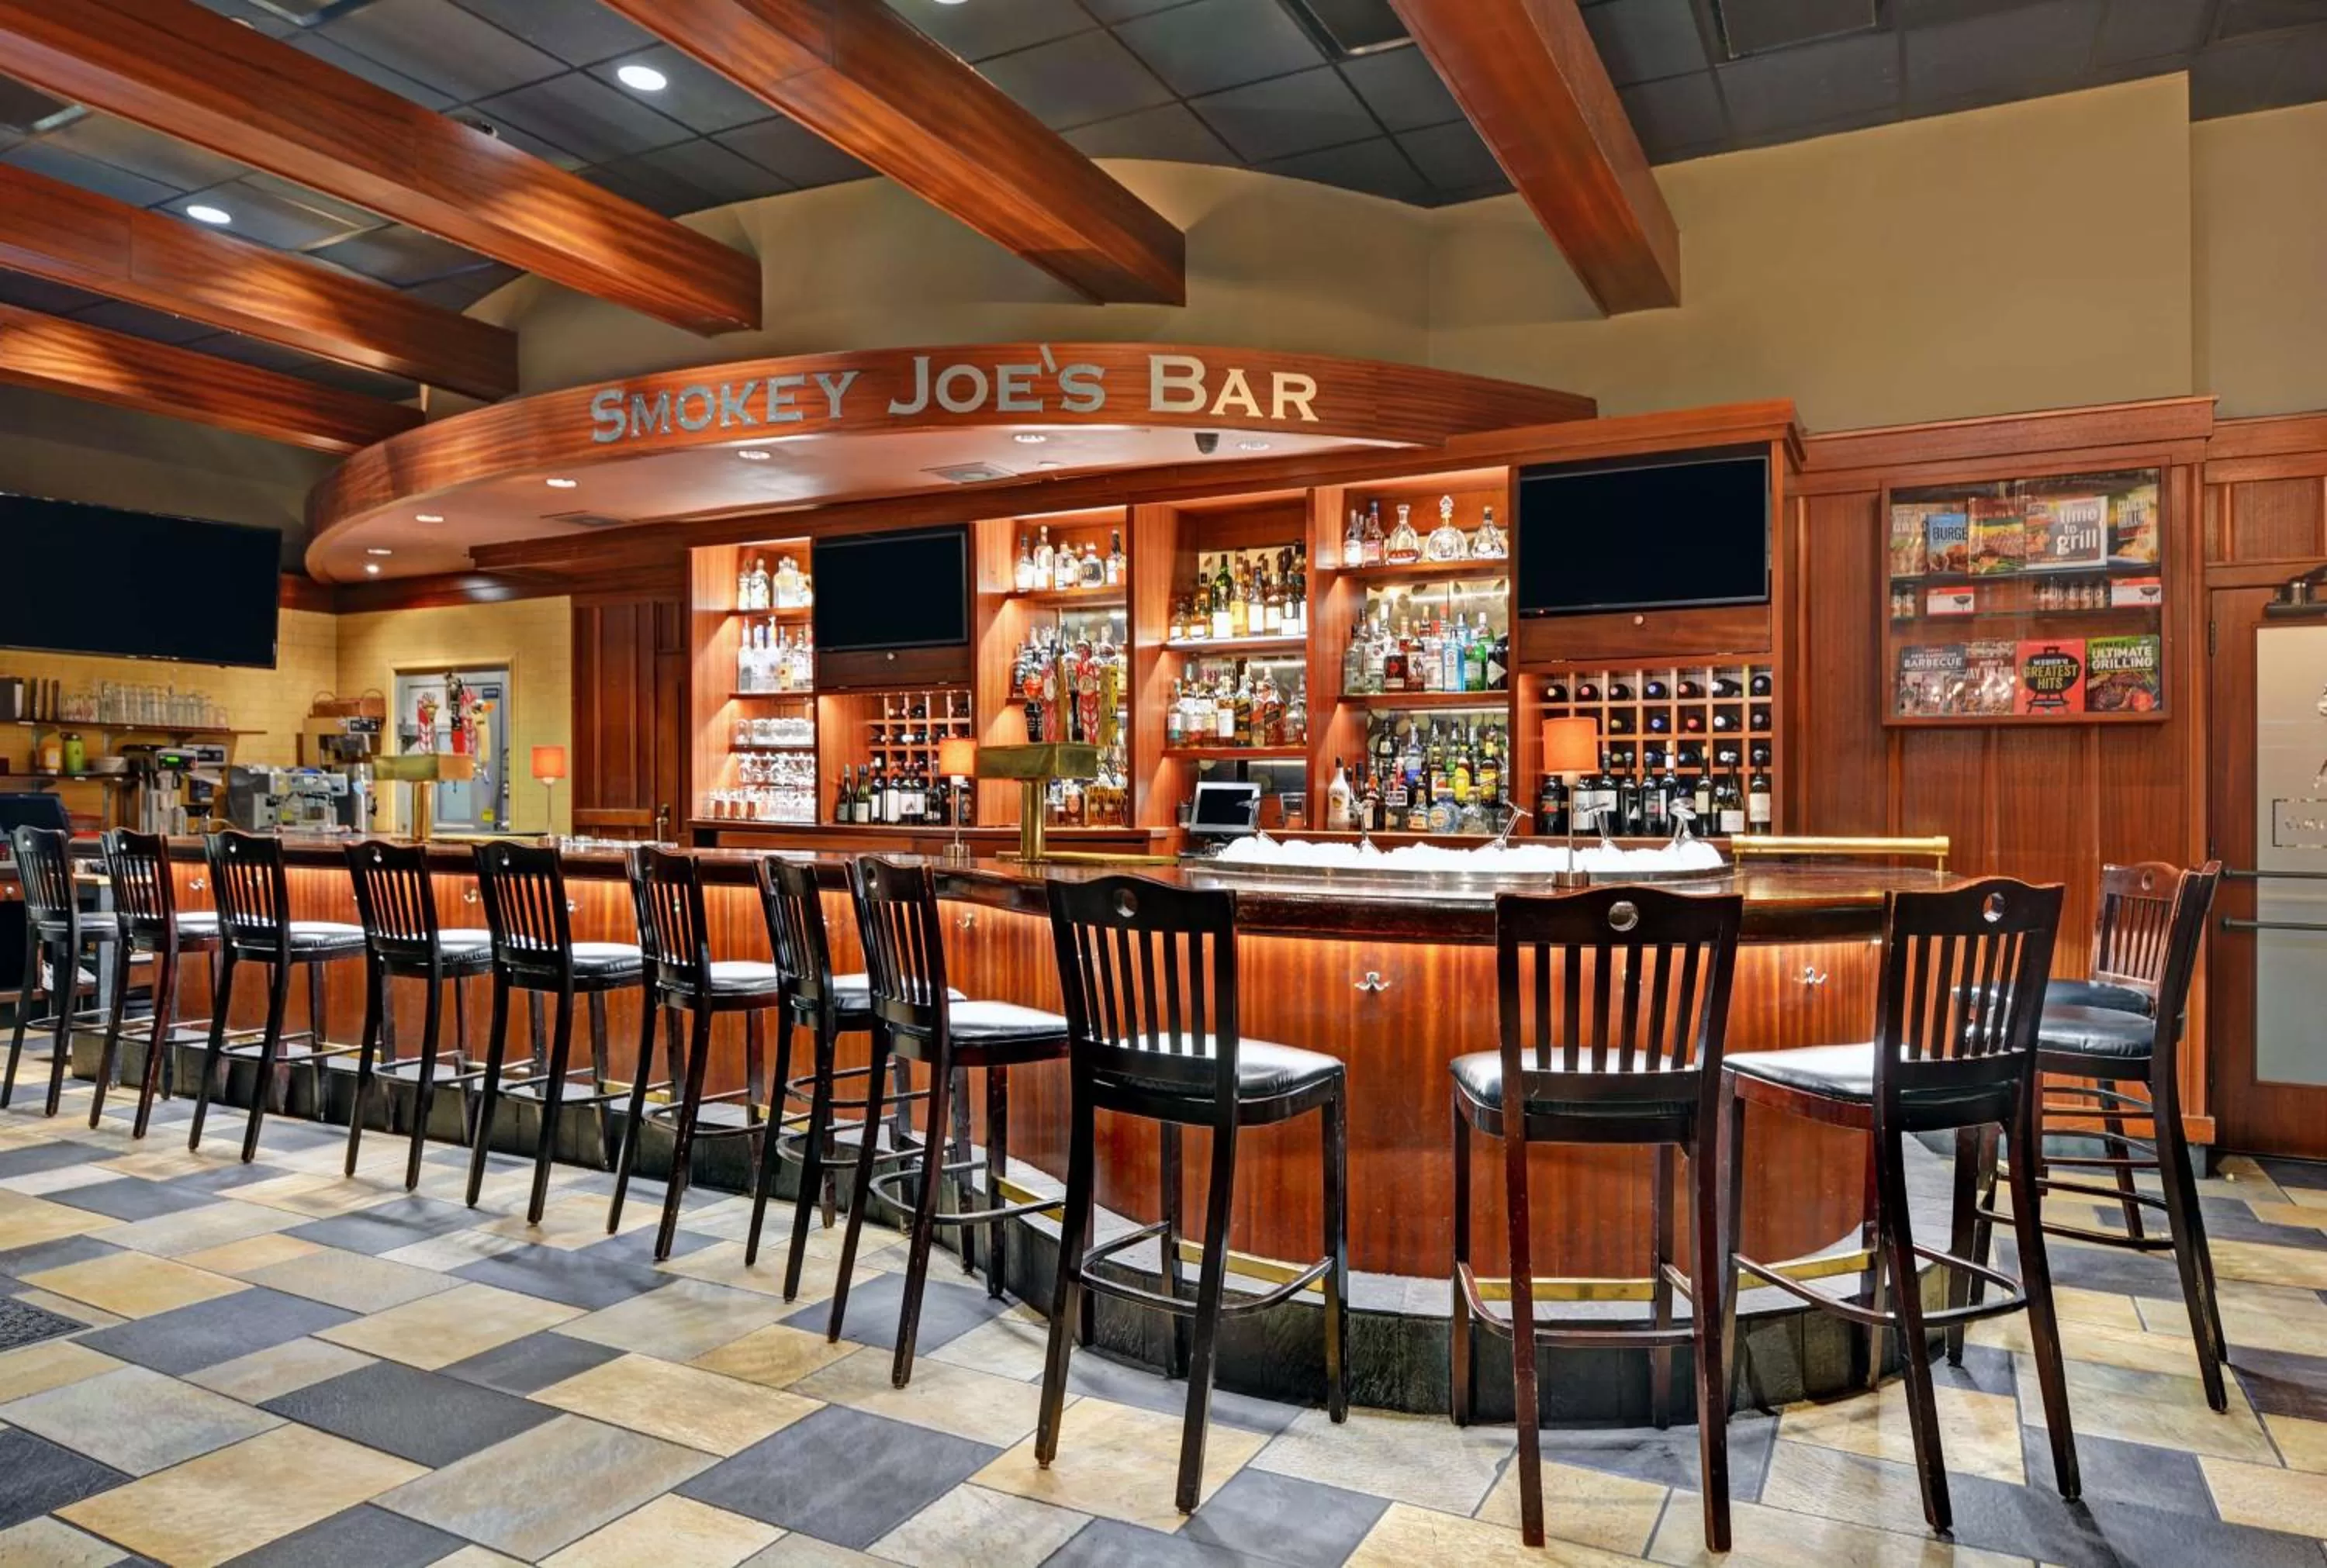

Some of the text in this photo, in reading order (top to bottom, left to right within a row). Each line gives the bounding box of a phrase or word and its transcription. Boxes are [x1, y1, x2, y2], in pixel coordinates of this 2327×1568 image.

[590, 344, 1319, 444] SMOKEY JOE'S BAR
[2059, 506, 2098, 523] time
[2064, 523, 2077, 534] to
[2056, 527, 2097, 555] grill
[2092, 646, 2152, 658] ULTIMATE
[1903, 657, 1962, 668] BARBECUE
[2092, 657, 2152, 670] GRILLING
[2023, 664, 2078, 679] GREATEST
[2037, 677, 2063, 689] HITS
